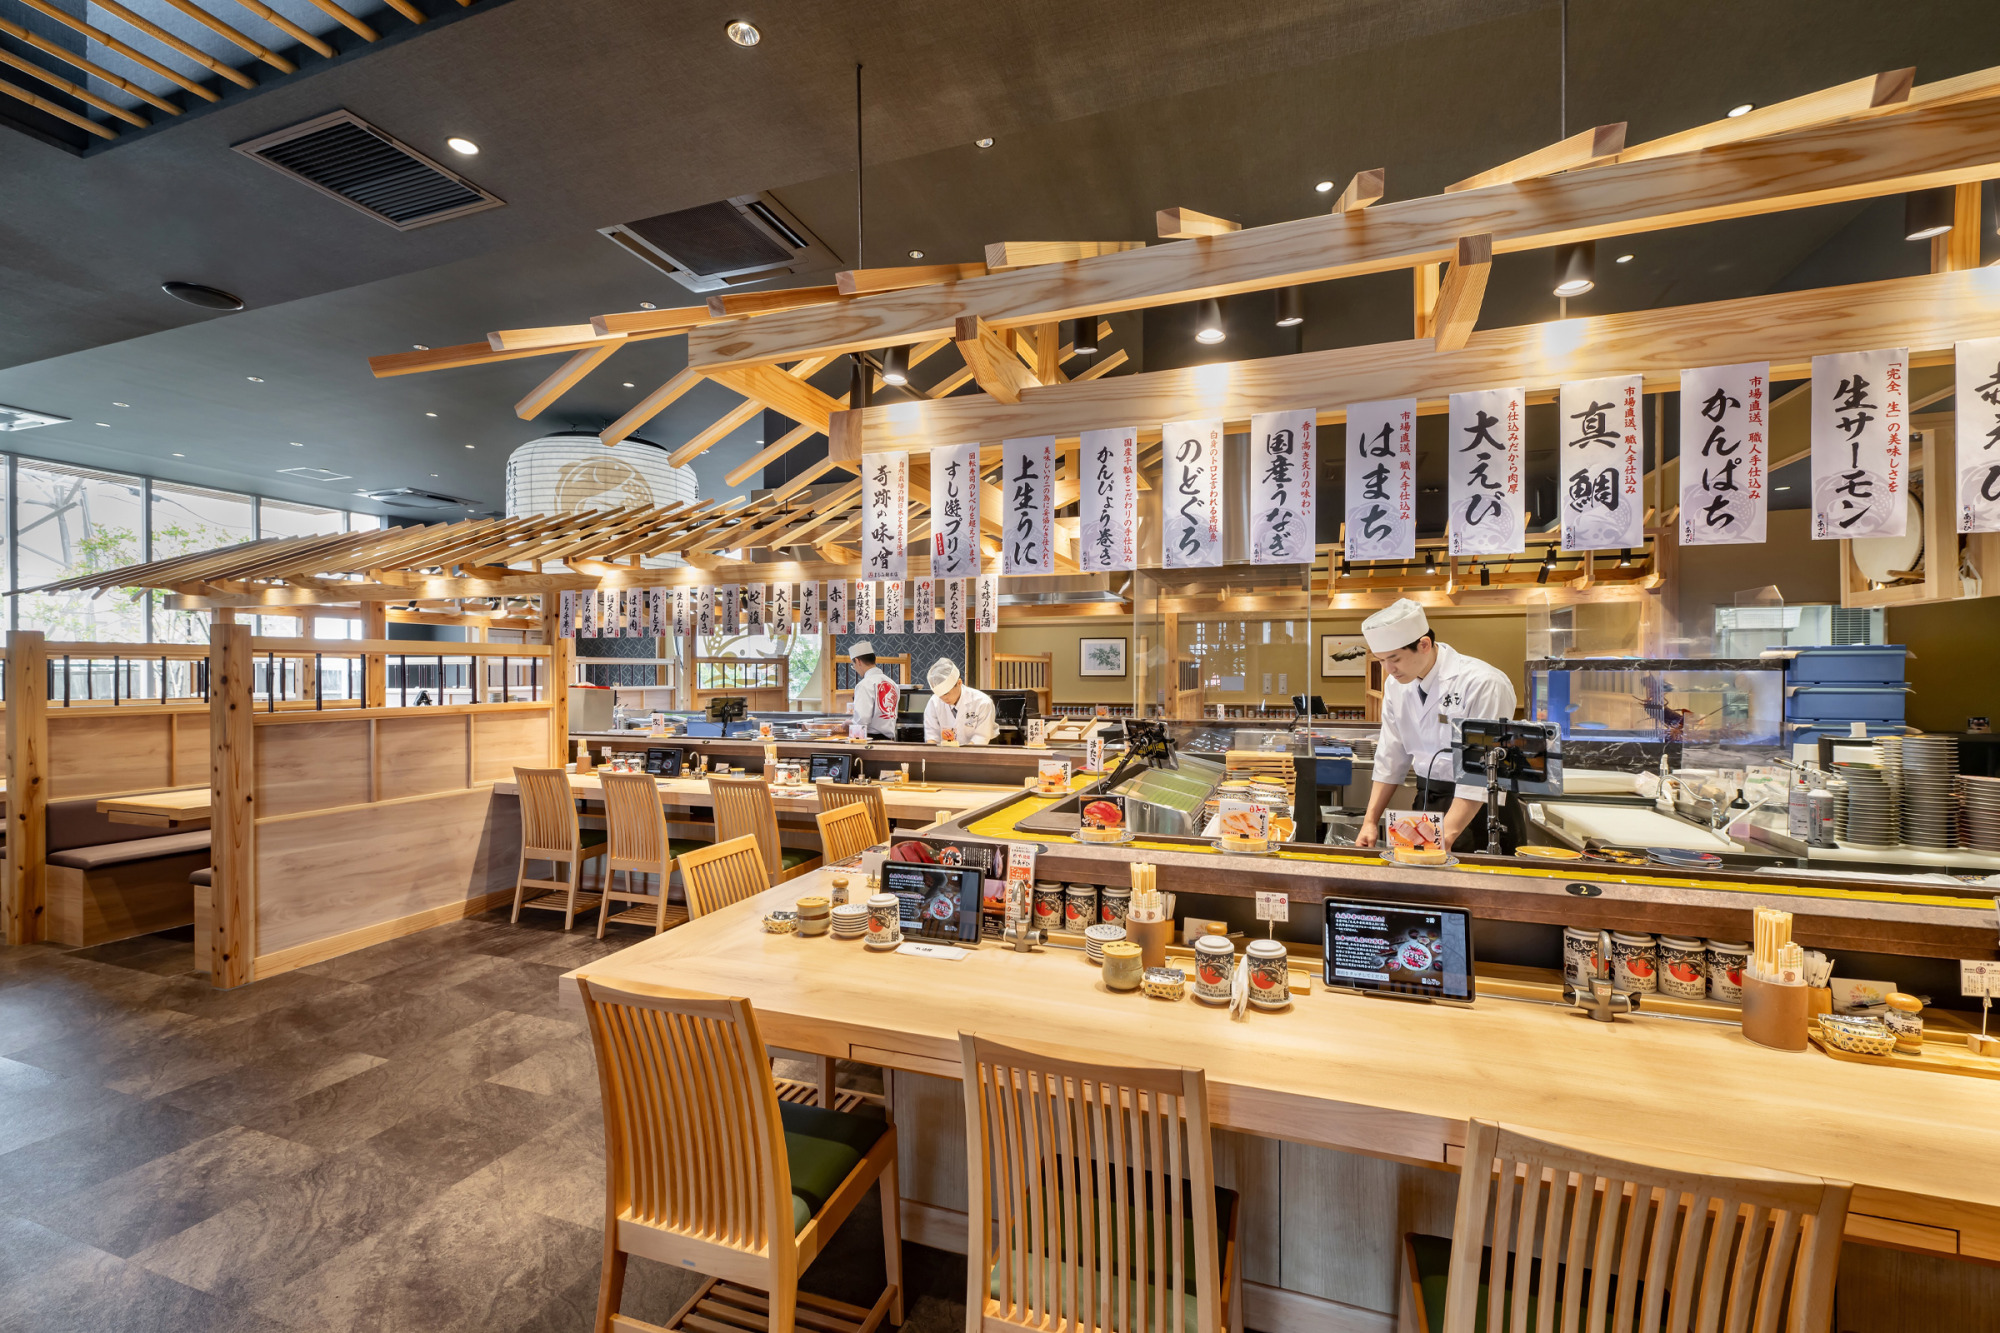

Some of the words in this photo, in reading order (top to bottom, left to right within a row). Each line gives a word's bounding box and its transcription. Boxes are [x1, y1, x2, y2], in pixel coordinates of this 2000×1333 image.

[1301, 422, 1311, 515] 香り高き炙りの味わい
[1359, 422, 1396, 541] はまち
[1400, 411, 1410, 519] 市場直送、職人手仕込み
[1460, 411, 1505, 525] 大えび
[1507, 400, 1520, 494] 手仕込みだから肉厚
[1569, 402, 1620, 513] 真鯛
[1624, 386, 1637, 494] 市場直送、職人手仕込み
[1701, 388, 1742, 529] かんぱち
[1748, 376, 1763, 499] 市場直送、職人手仕込み
[1833, 375, 1877, 528] 生サーモン
[1885, 362, 1902, 493] 「完全、生」の美味しさを
[871, 465, 894, 570] 奇跡の味噌
[945, 461, 962, 572] すし遊プリン
[968, 452, 977, 567] 回転寿司のレベルを超えています。
[1013, 455, 1038, 565] 上生うに
[1097, 447, 1113, 565] かんぴょう巻き
[1123, 438, 1133, 562] 国産干瓢をこだわりの手仕込み
[1176, 440, 1204, 555] のどぐろ
[1209, 431, 1218, 539] 白身のトロと言われる高級魚
[1263, 429, 1294, 556] 国産うなぎ
[775, 588, 788, 632] 大とろ
[802, 586, 814, 631] 中とろ
[828, 586, 843, 624] 赤身
[949, 581, 959, 630] 職人あなご
[1429, 814, 1441, 846] 中とろ
[1579, 885, 1588, 895] 2
